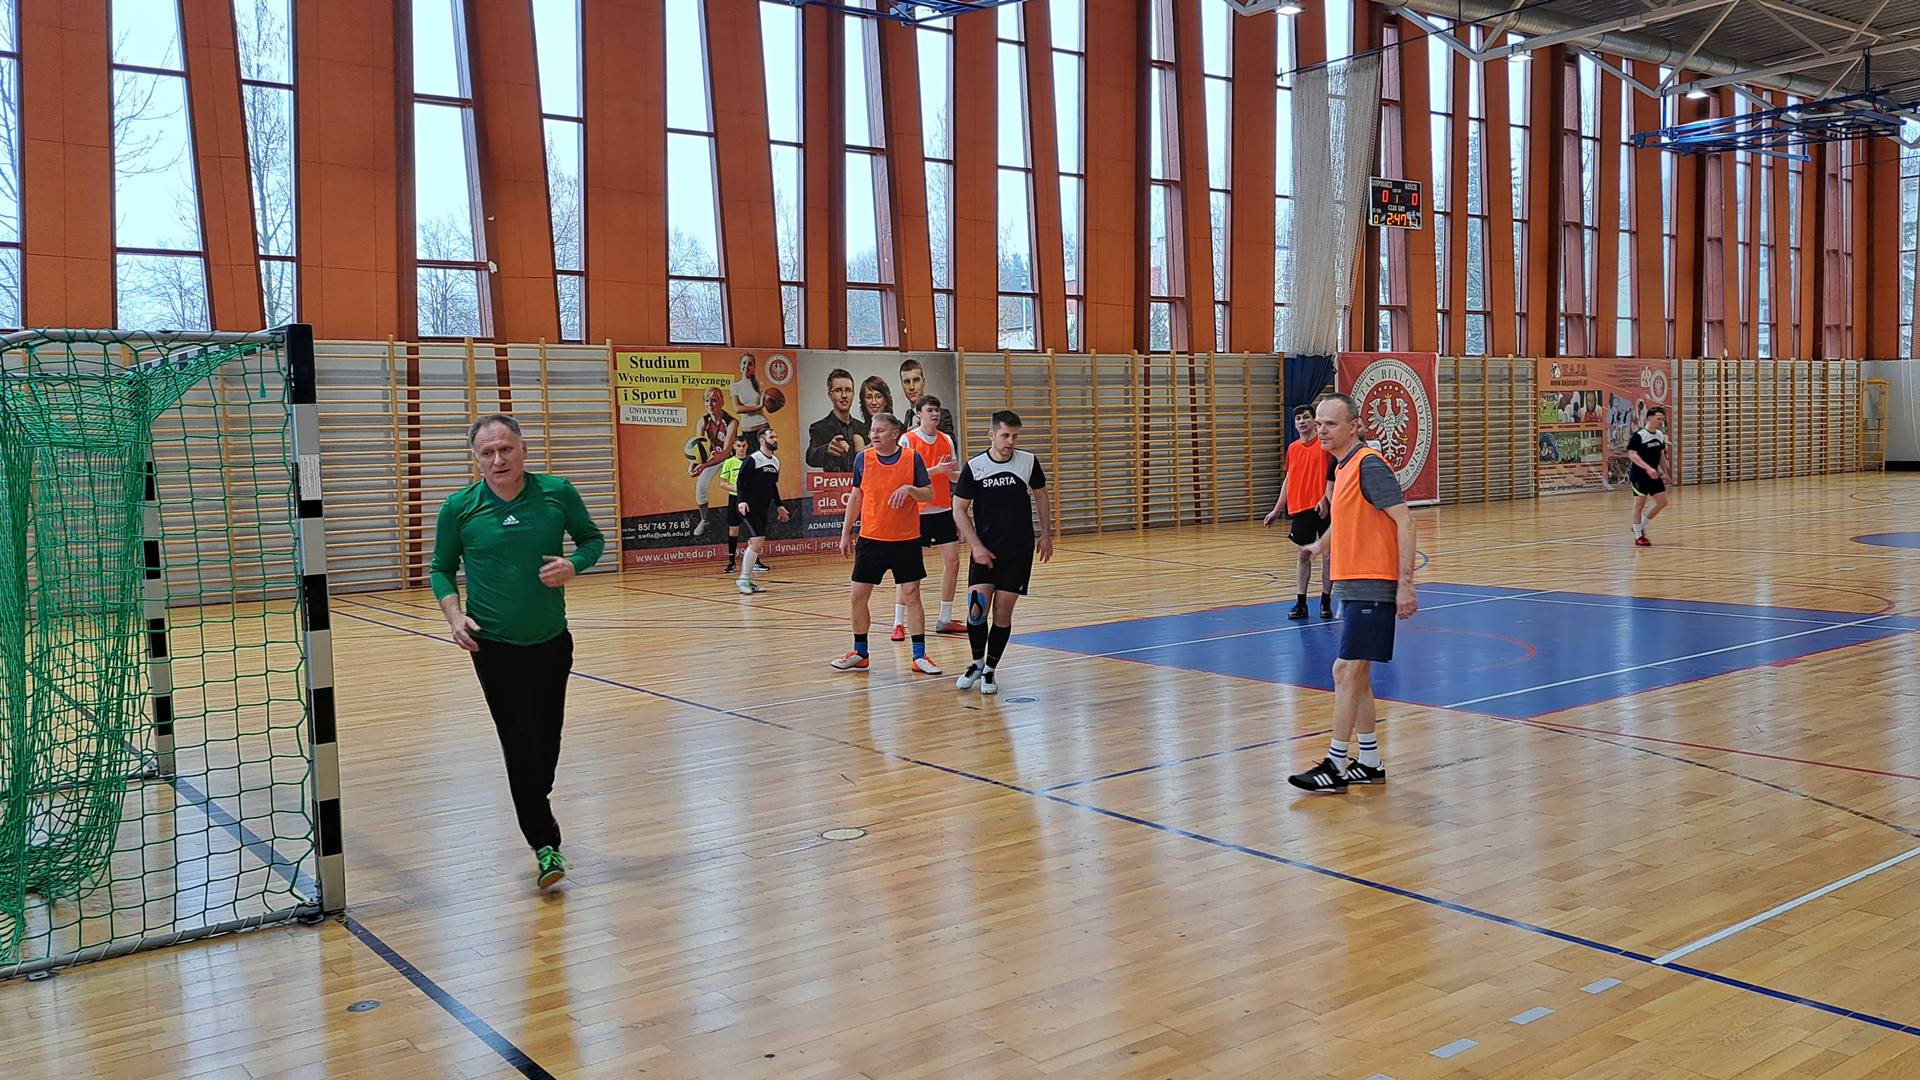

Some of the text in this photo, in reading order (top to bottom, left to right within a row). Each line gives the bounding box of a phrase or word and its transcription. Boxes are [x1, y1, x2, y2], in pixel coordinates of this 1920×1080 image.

[1382, 190, 1388, 202] 0
[1412, 193, 1418, 205] 0
[629, 356, 690, 369] Studium
[617, 372, 731, 387] Wychowania Fizycznego
[623, 388, 677, 404] i Sportu
[629, 407, 680, 416] UNIWERSYTET
[630, 415, 683, 424] BIAŁYMSTOKU
[982, 476, 1017, 488] SPARTA
[818, 496, 837, 507] dla
[653, 522, 667, 530] 745
[669, 522, 679, 530] 76
[680, 521, 690, 529] 85
[775, 542, 812, 553] dynamic
[635, 551, 717, 563] www.uwb.edu.pl
